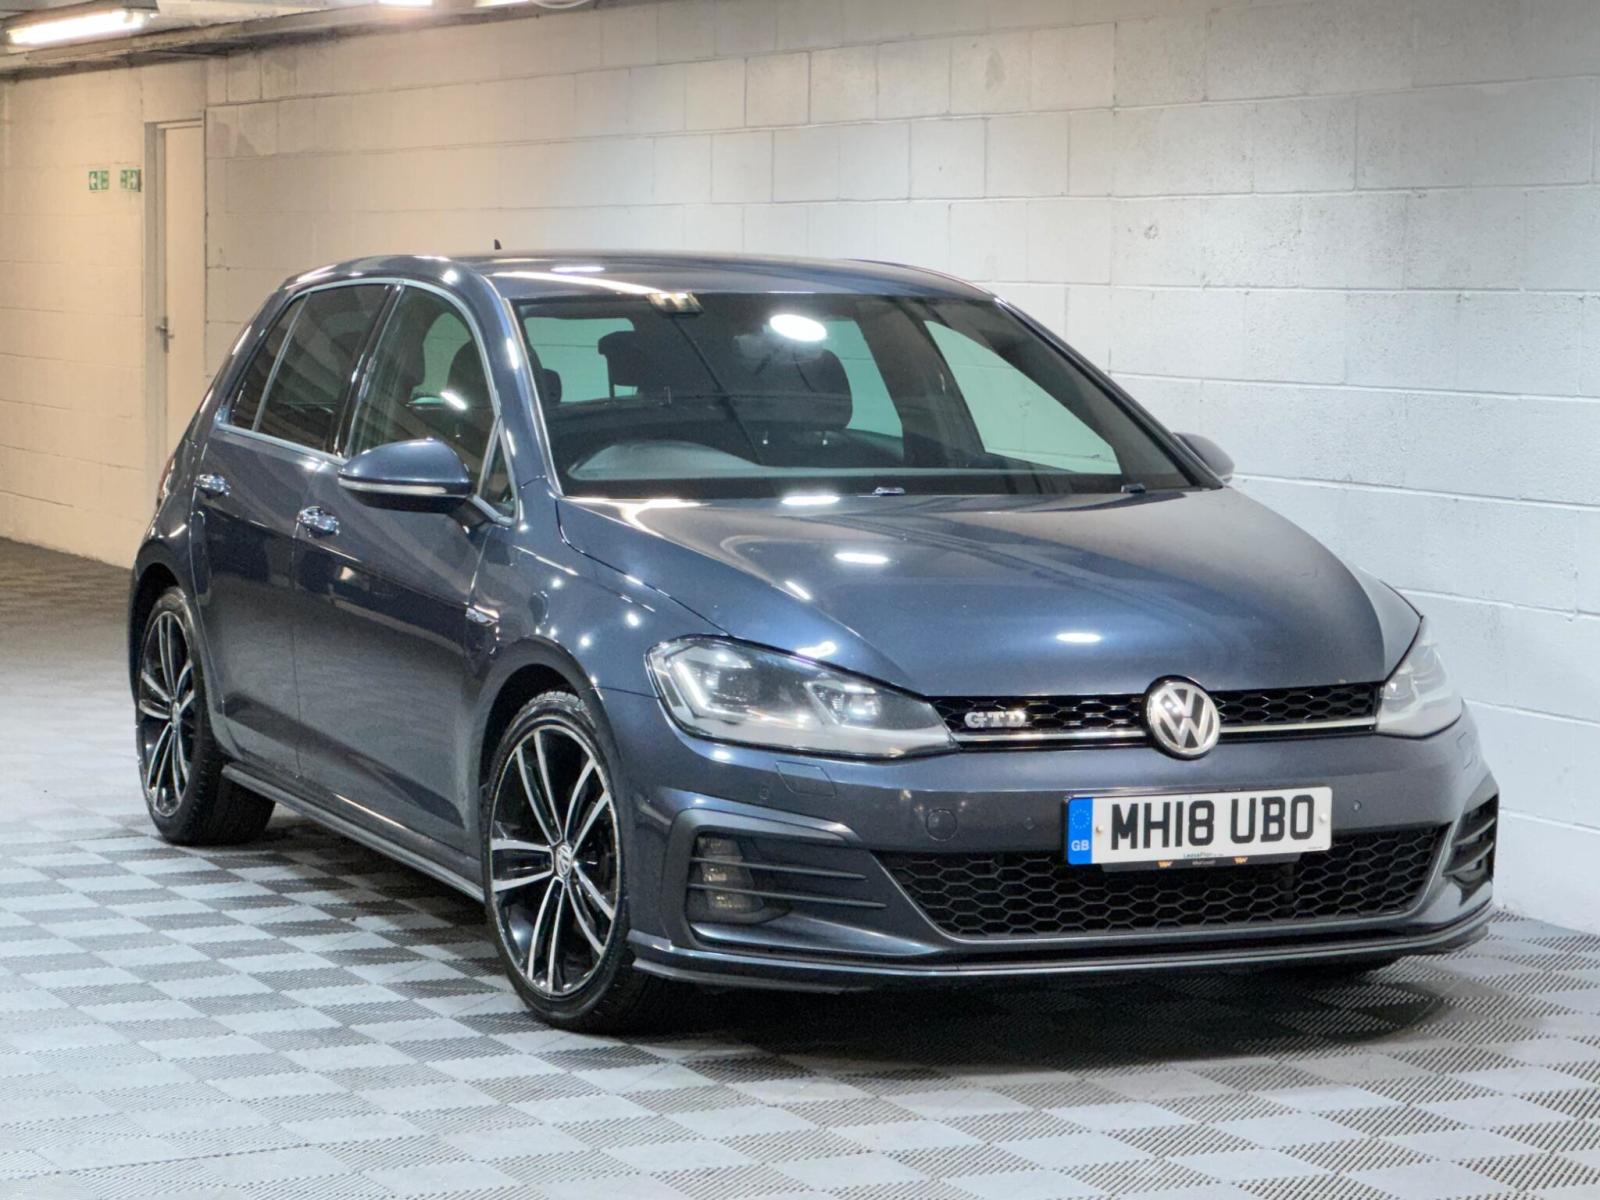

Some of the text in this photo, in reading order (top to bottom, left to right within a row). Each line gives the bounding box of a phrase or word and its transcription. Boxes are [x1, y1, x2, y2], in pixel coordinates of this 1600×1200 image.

[964, 711, 1026, 728] GTD
[1111, 794, 1315, 851] MH18 UBO
[1071, 840, 1090, 851] GB
